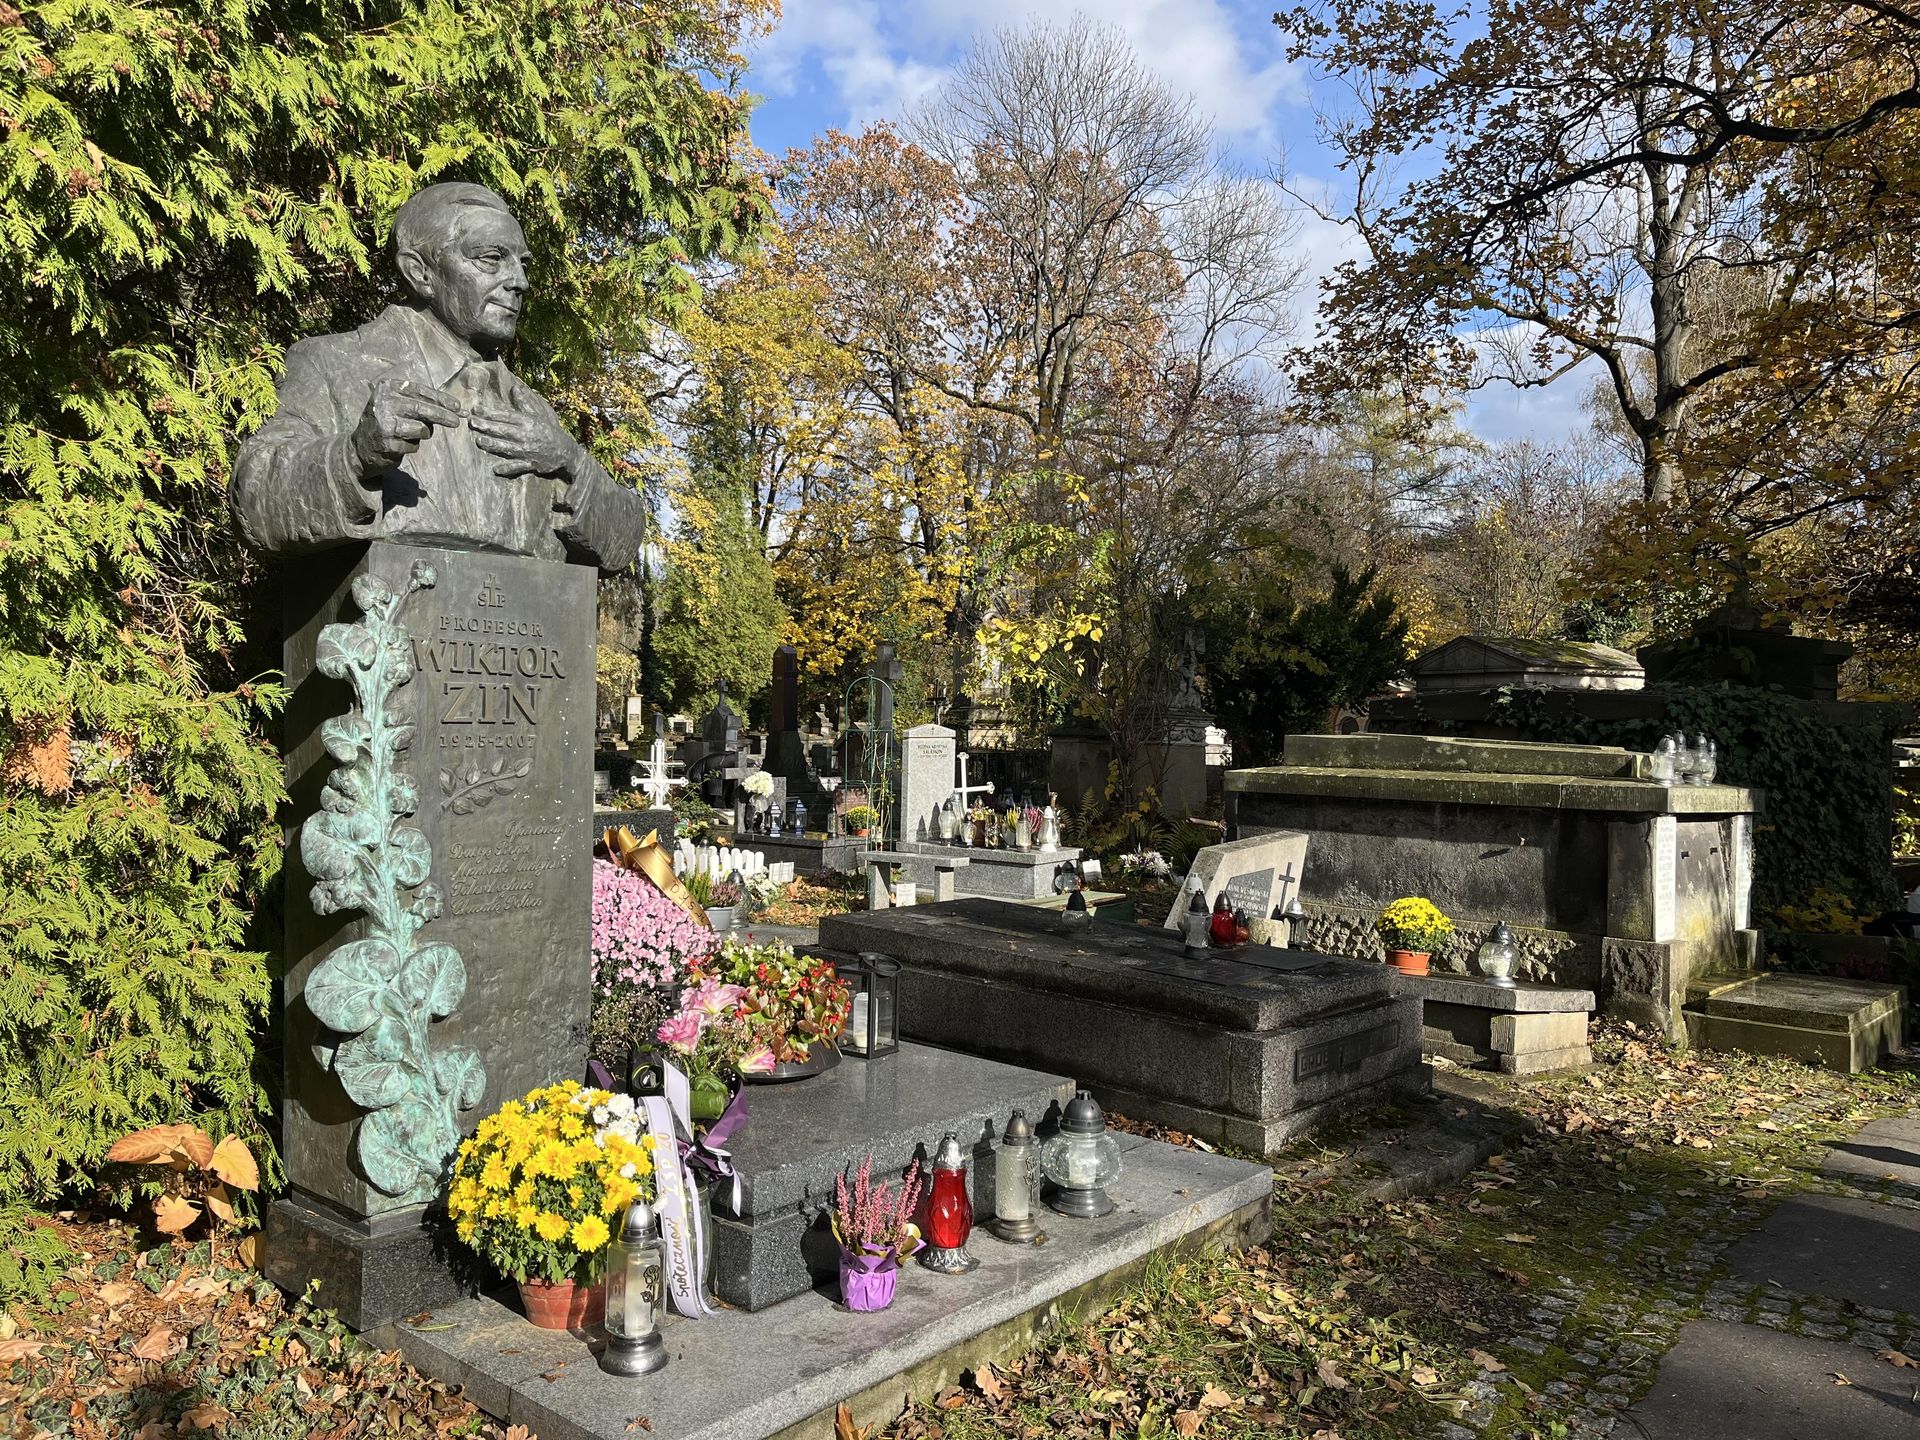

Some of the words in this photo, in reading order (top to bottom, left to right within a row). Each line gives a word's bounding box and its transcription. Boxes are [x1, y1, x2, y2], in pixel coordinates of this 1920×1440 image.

[439, 615, 544, 638] PROFESOR
[410, 635, 566, 680] WIKTOR
[441, 681, 541, 726] ZIN
[439, 735, 537, 749] 1925-2007
[656, 1132, 673, 1152] 20
[666, 1217, 690, 1298] Społeczność
